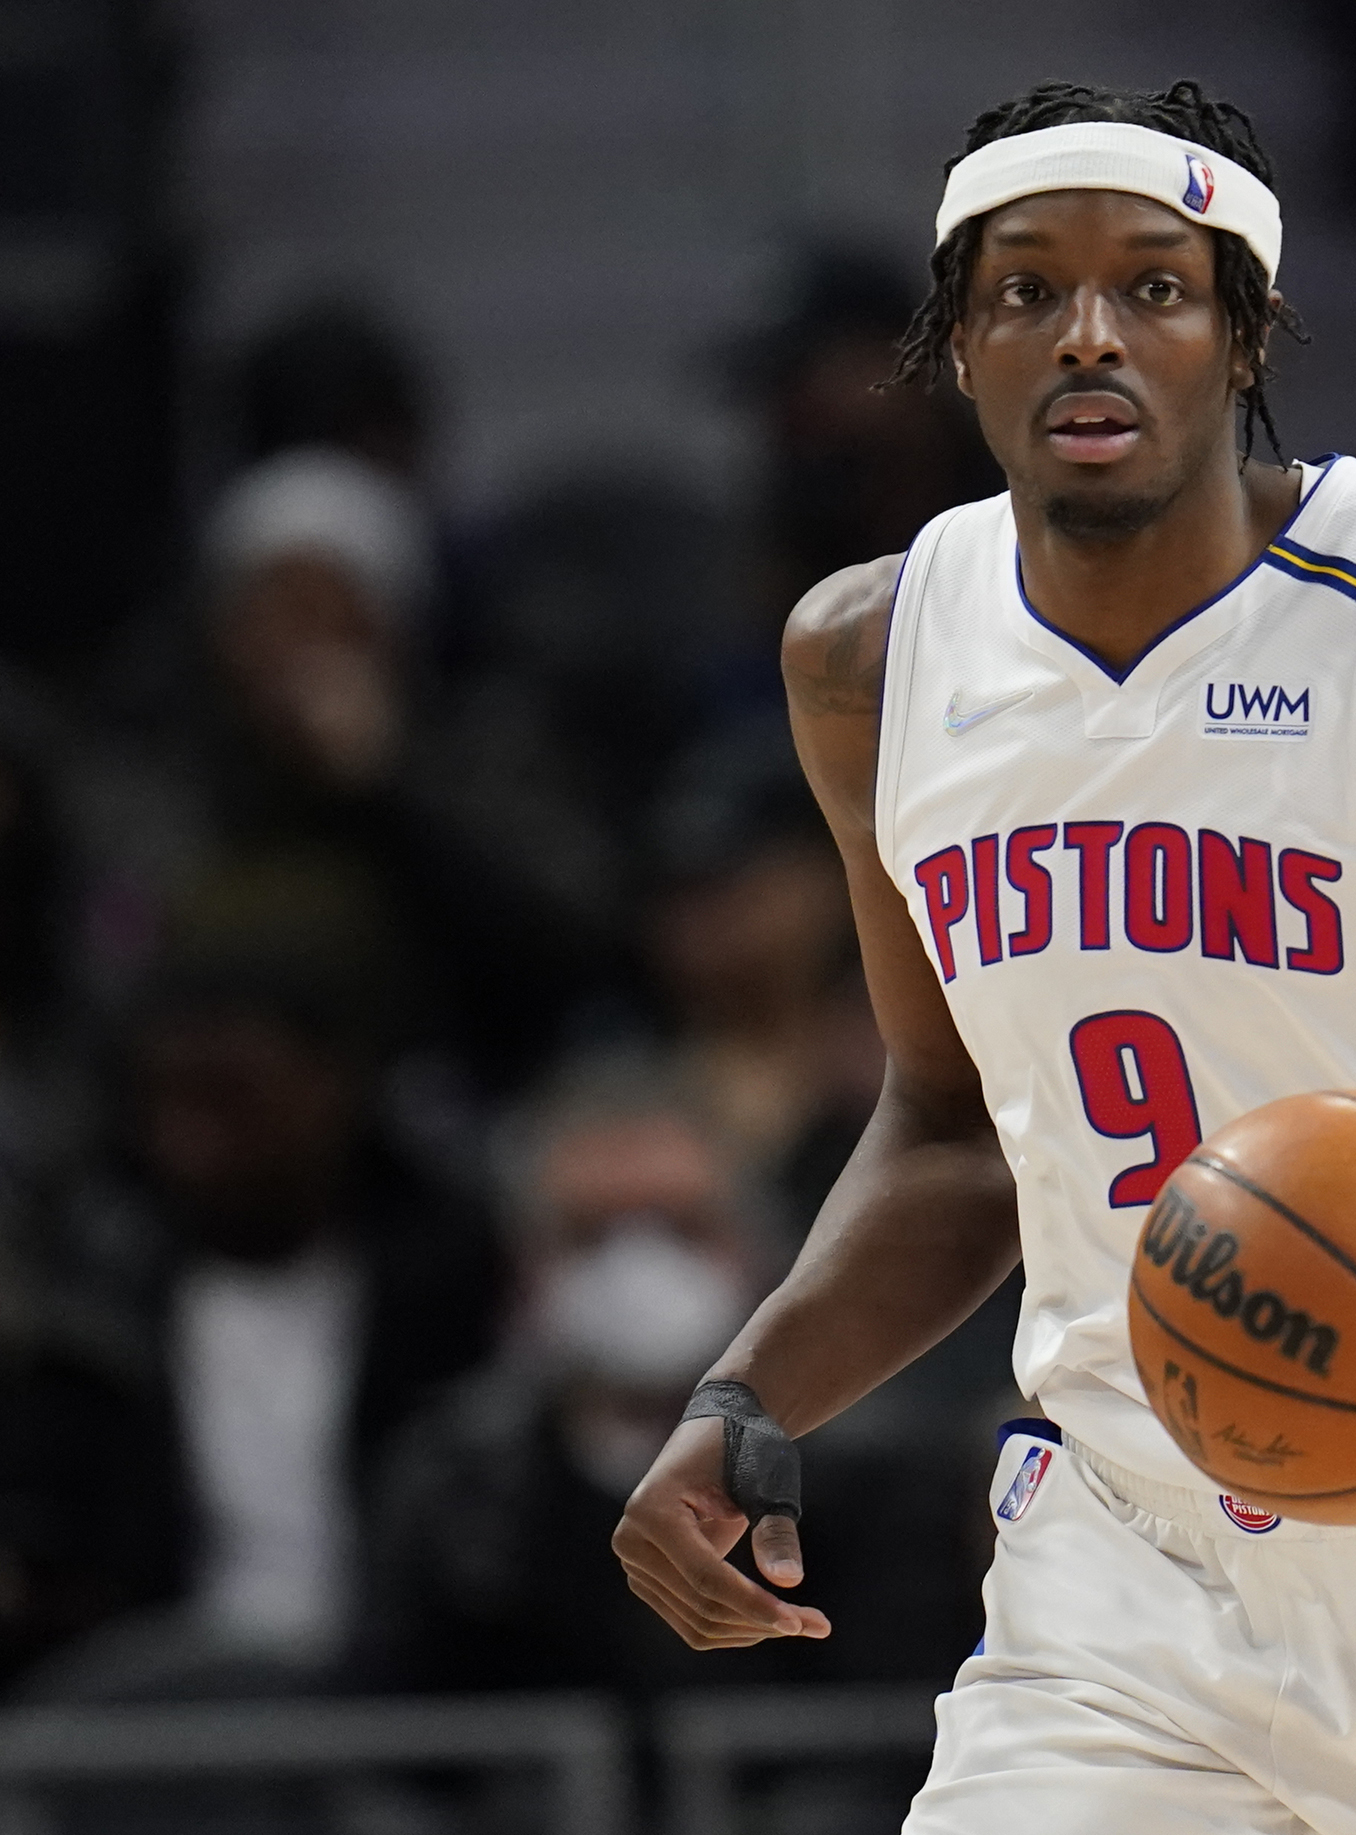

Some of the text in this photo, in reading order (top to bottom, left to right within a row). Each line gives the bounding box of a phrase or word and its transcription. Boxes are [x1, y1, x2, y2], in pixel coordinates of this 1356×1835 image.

[1204, 727, 1229, 735] UNITED
[1270, 728, 1309, 737] MORTGAGE
[1206, 682, 1310, 722] UWM
[914, 820, 1345, 985] PISTONS
[1069, 1009, 1203, 1209] 9
[1144, 1185, 1339, 1377] Wilson
